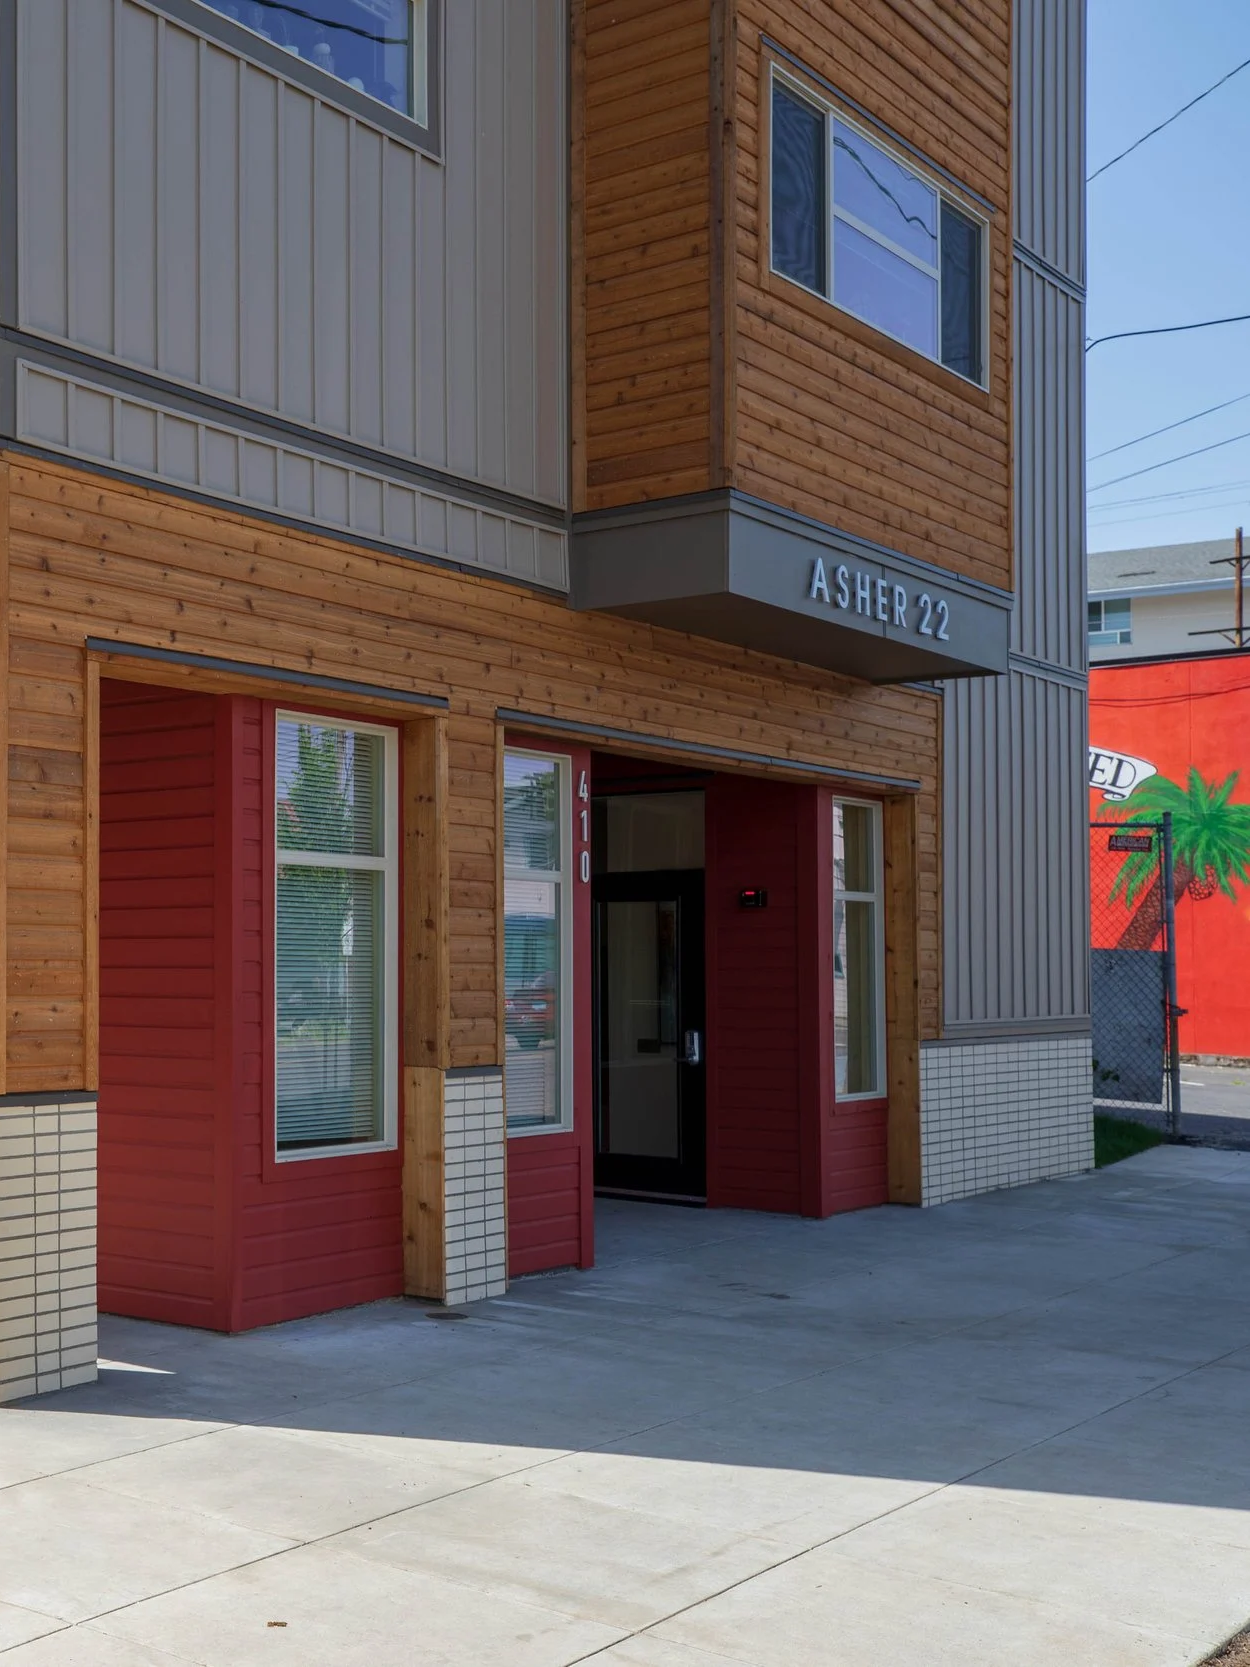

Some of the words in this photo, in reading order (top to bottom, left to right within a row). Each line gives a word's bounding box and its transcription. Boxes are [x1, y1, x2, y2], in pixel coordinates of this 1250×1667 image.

[810, 557, 907, 628] ASHER
[917, 593, 950, 641] 22
[1089, 752, 1136, 789] ED
[578, 770, 590, 883] 410
